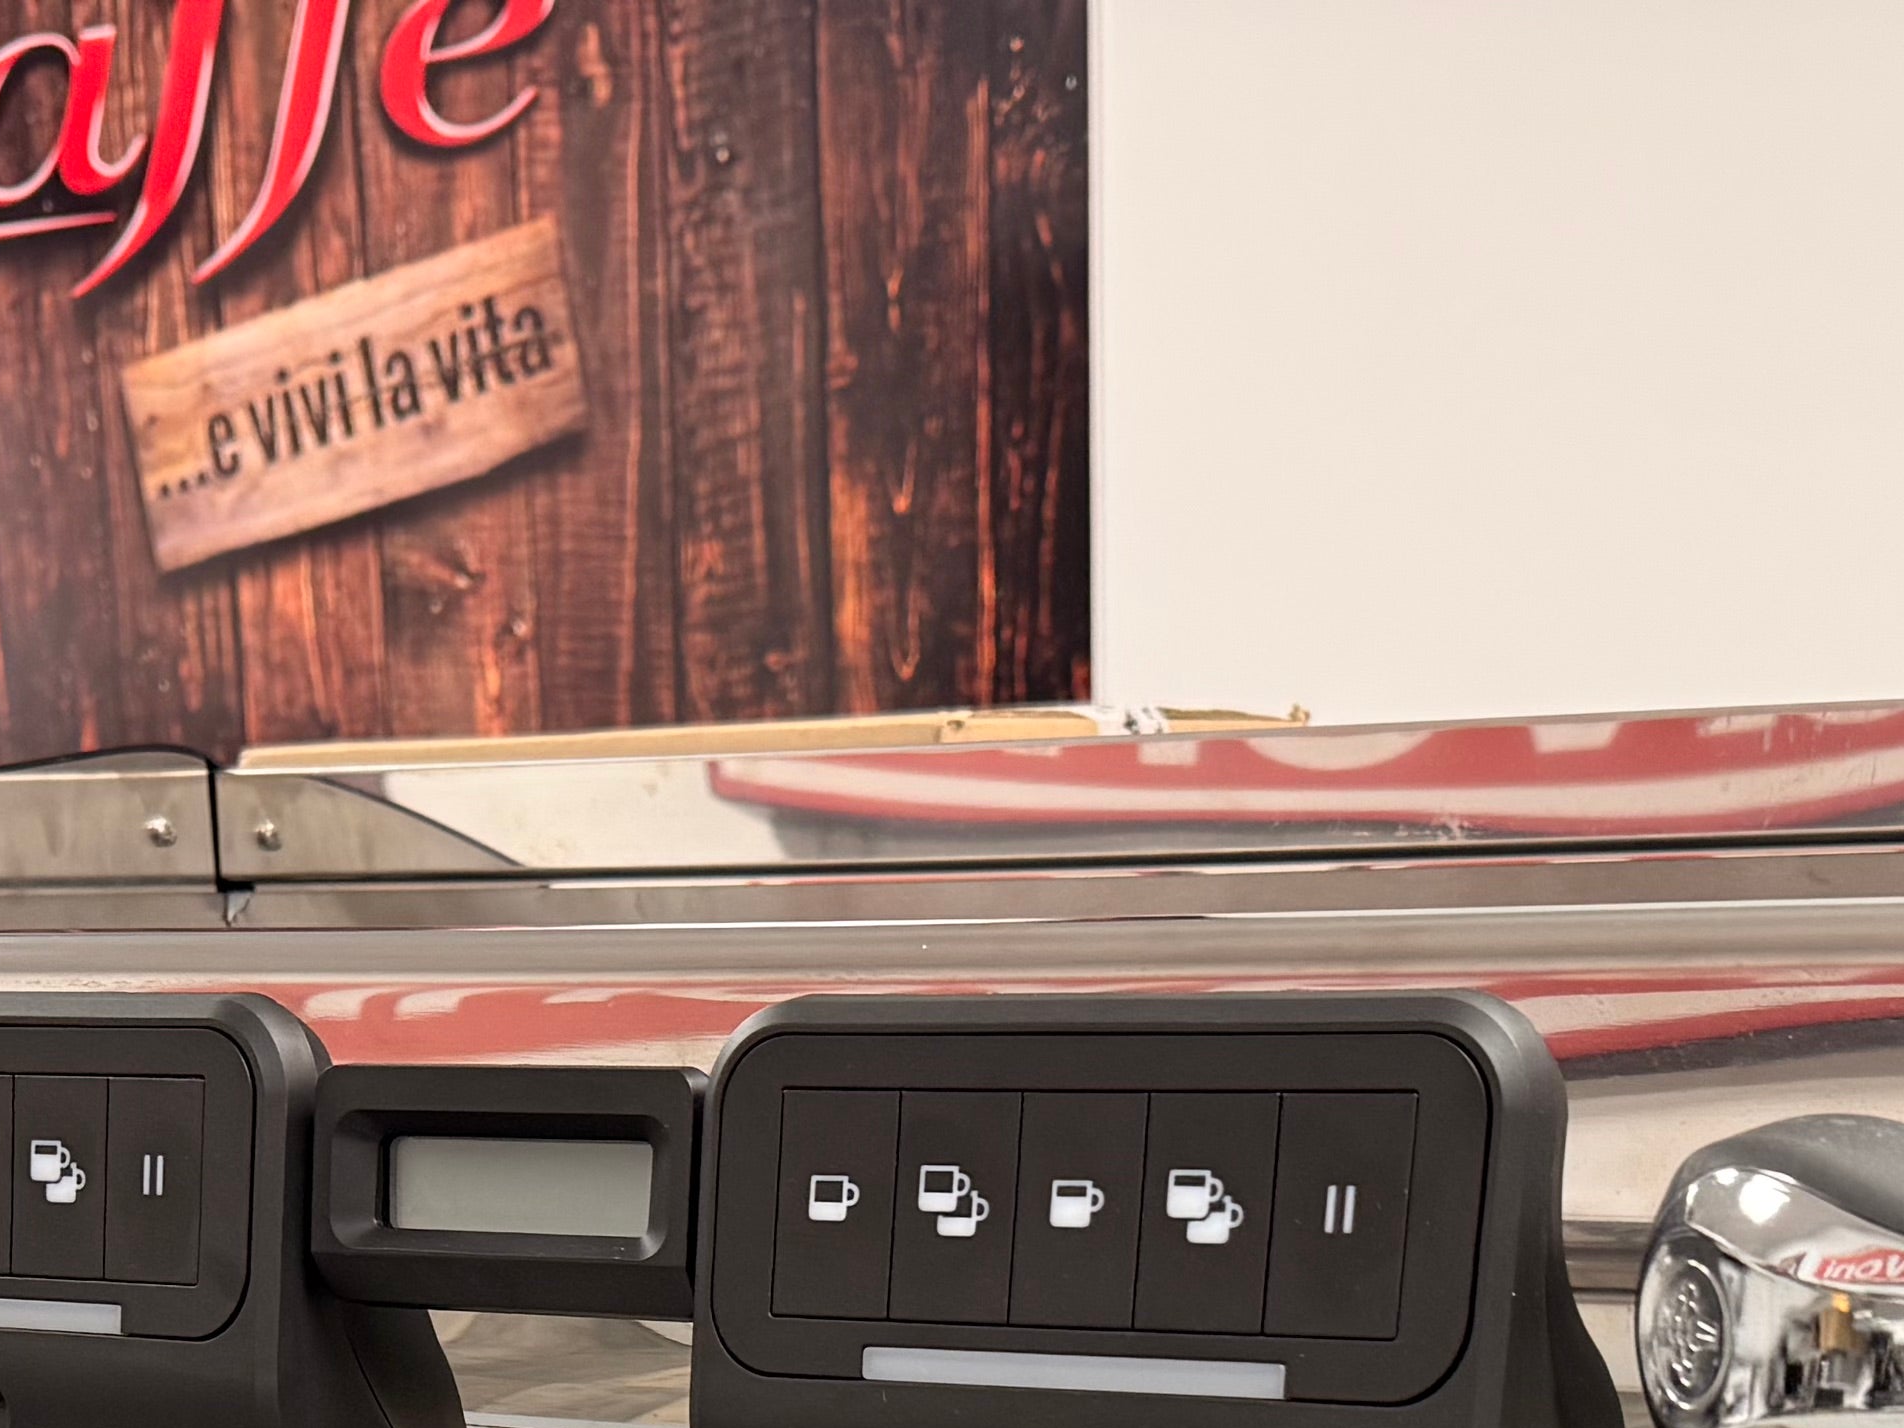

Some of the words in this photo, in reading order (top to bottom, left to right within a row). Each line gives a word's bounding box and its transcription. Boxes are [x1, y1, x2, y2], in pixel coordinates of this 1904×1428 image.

[249, 351, 355, 465] vivi
[358, 335, 422, 430] la
[429, 296, 555, 404] vita
